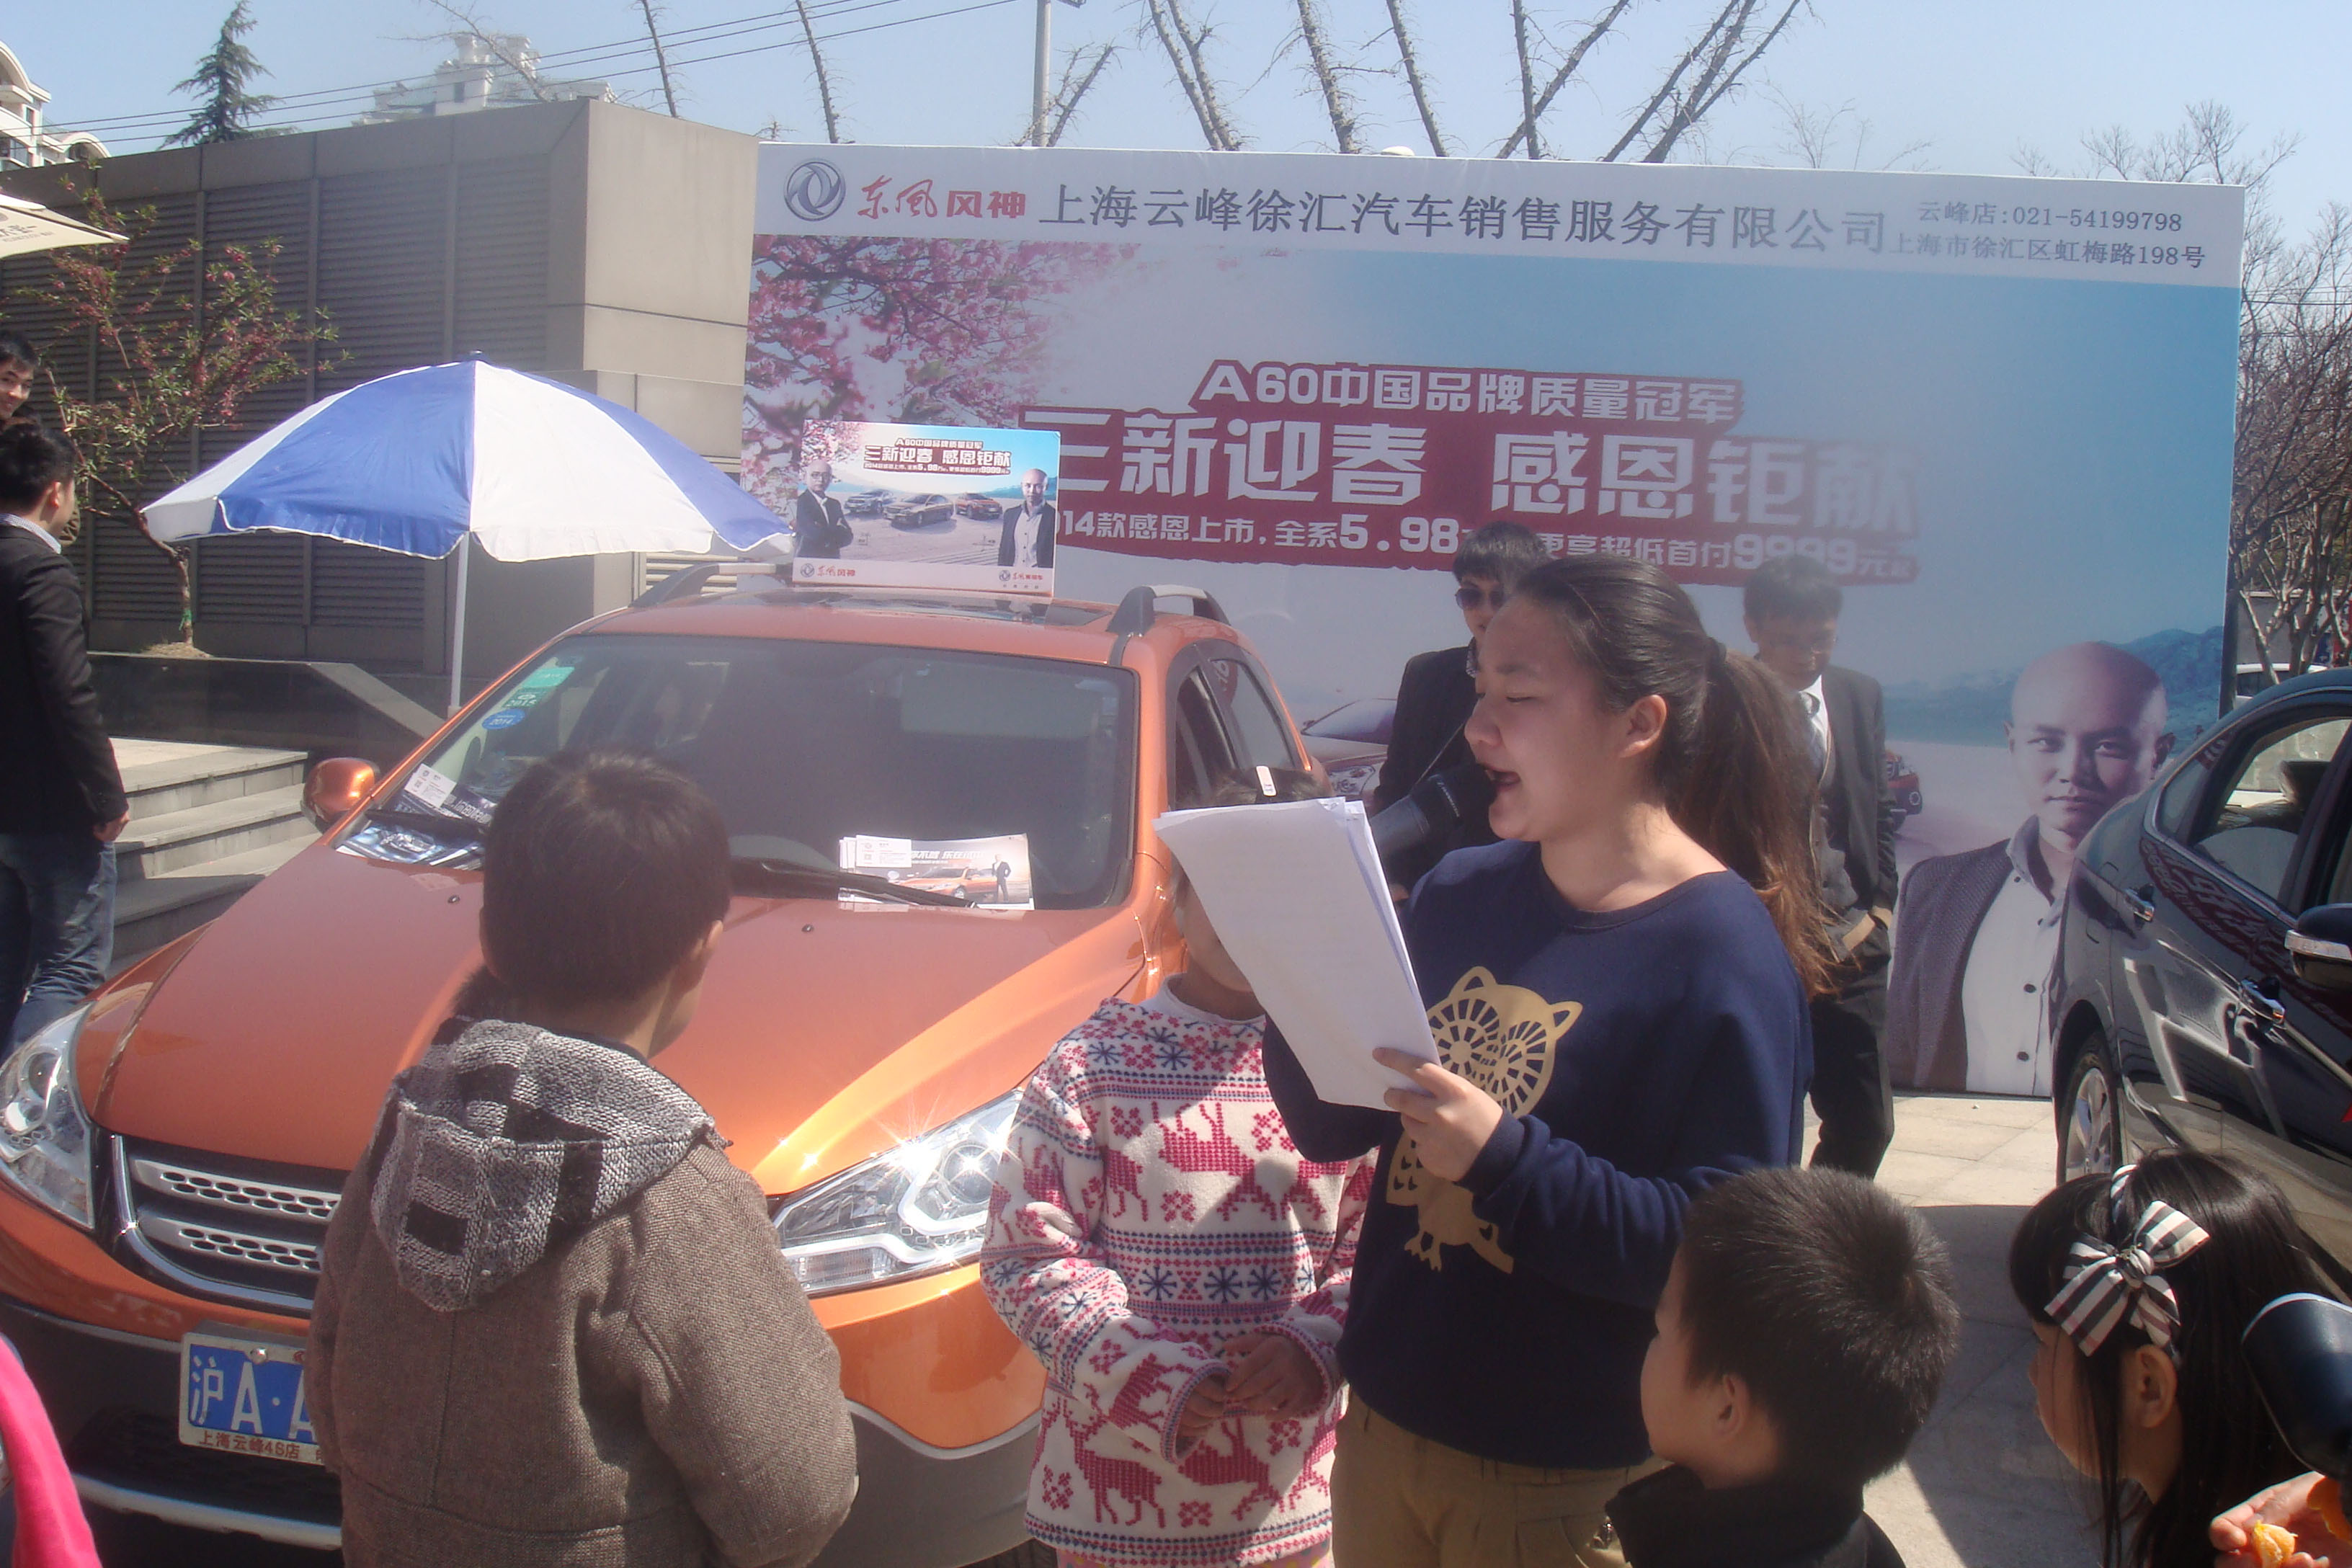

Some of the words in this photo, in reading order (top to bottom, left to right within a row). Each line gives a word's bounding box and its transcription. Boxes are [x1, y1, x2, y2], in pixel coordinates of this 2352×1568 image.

[1039, 184, 1885, 253] 上海云峰徐汇汽车销售服务有限公司
[1889, 233, 2206, 269] 上海市徐汇区虹梅路198号
[1199, 365, 1737, 425] A60中国品牌质量冠军
[865, 445, 933, 463] 三新迎春
[942, 450, 1011, 467] 感恩钜献
[1024, 410, 1427, 507] 三新迎春
[1491, 430, 1915, 533] 感恩钜献
[200, 1430, 300, 1460] 上海云峰4S店
